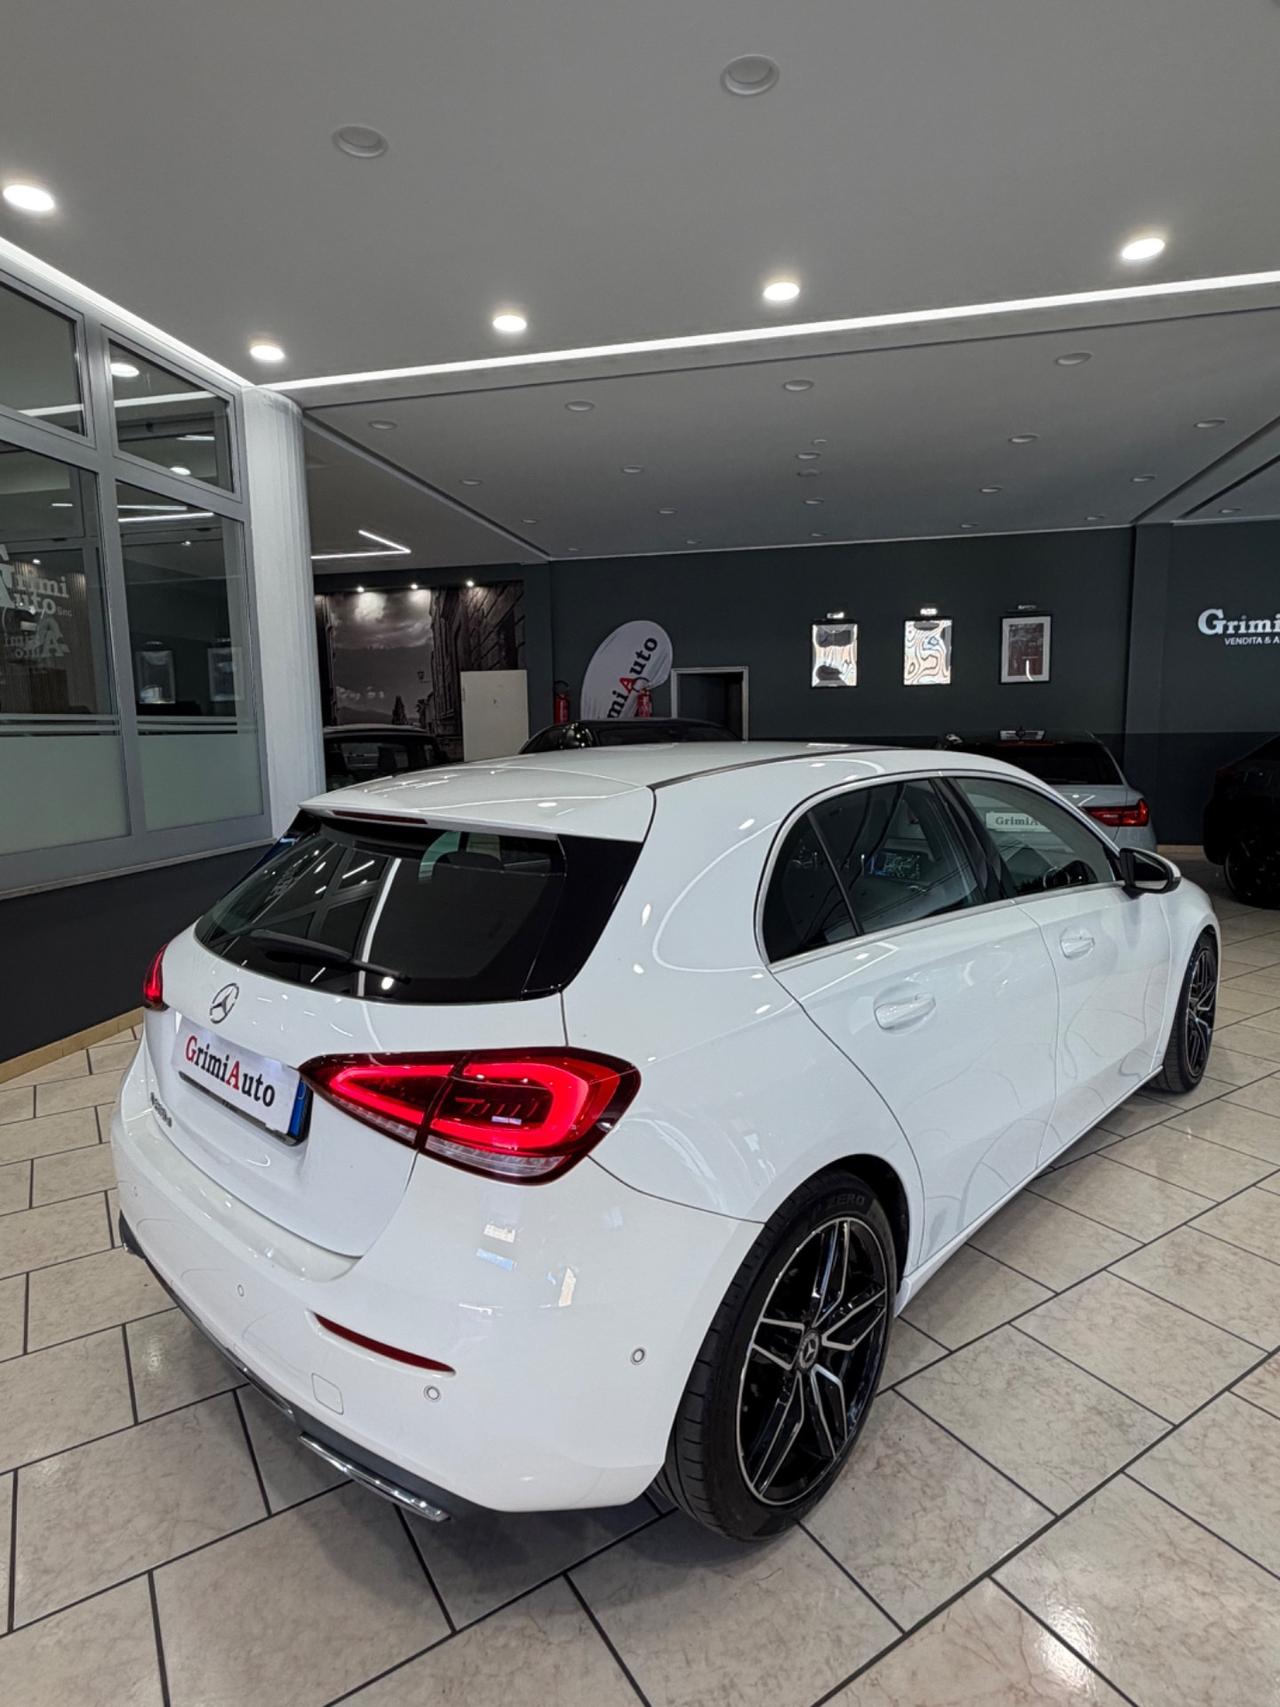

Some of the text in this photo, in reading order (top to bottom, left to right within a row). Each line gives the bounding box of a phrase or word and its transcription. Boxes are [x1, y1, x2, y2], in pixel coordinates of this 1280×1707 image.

[1198, 608, 1280, 635] Grimi
[1224, 637, 1262, 645] VENDITA
[1264, 636, 1271, 644] &
[185, 1035, 276, 1107] GrimiAuto
